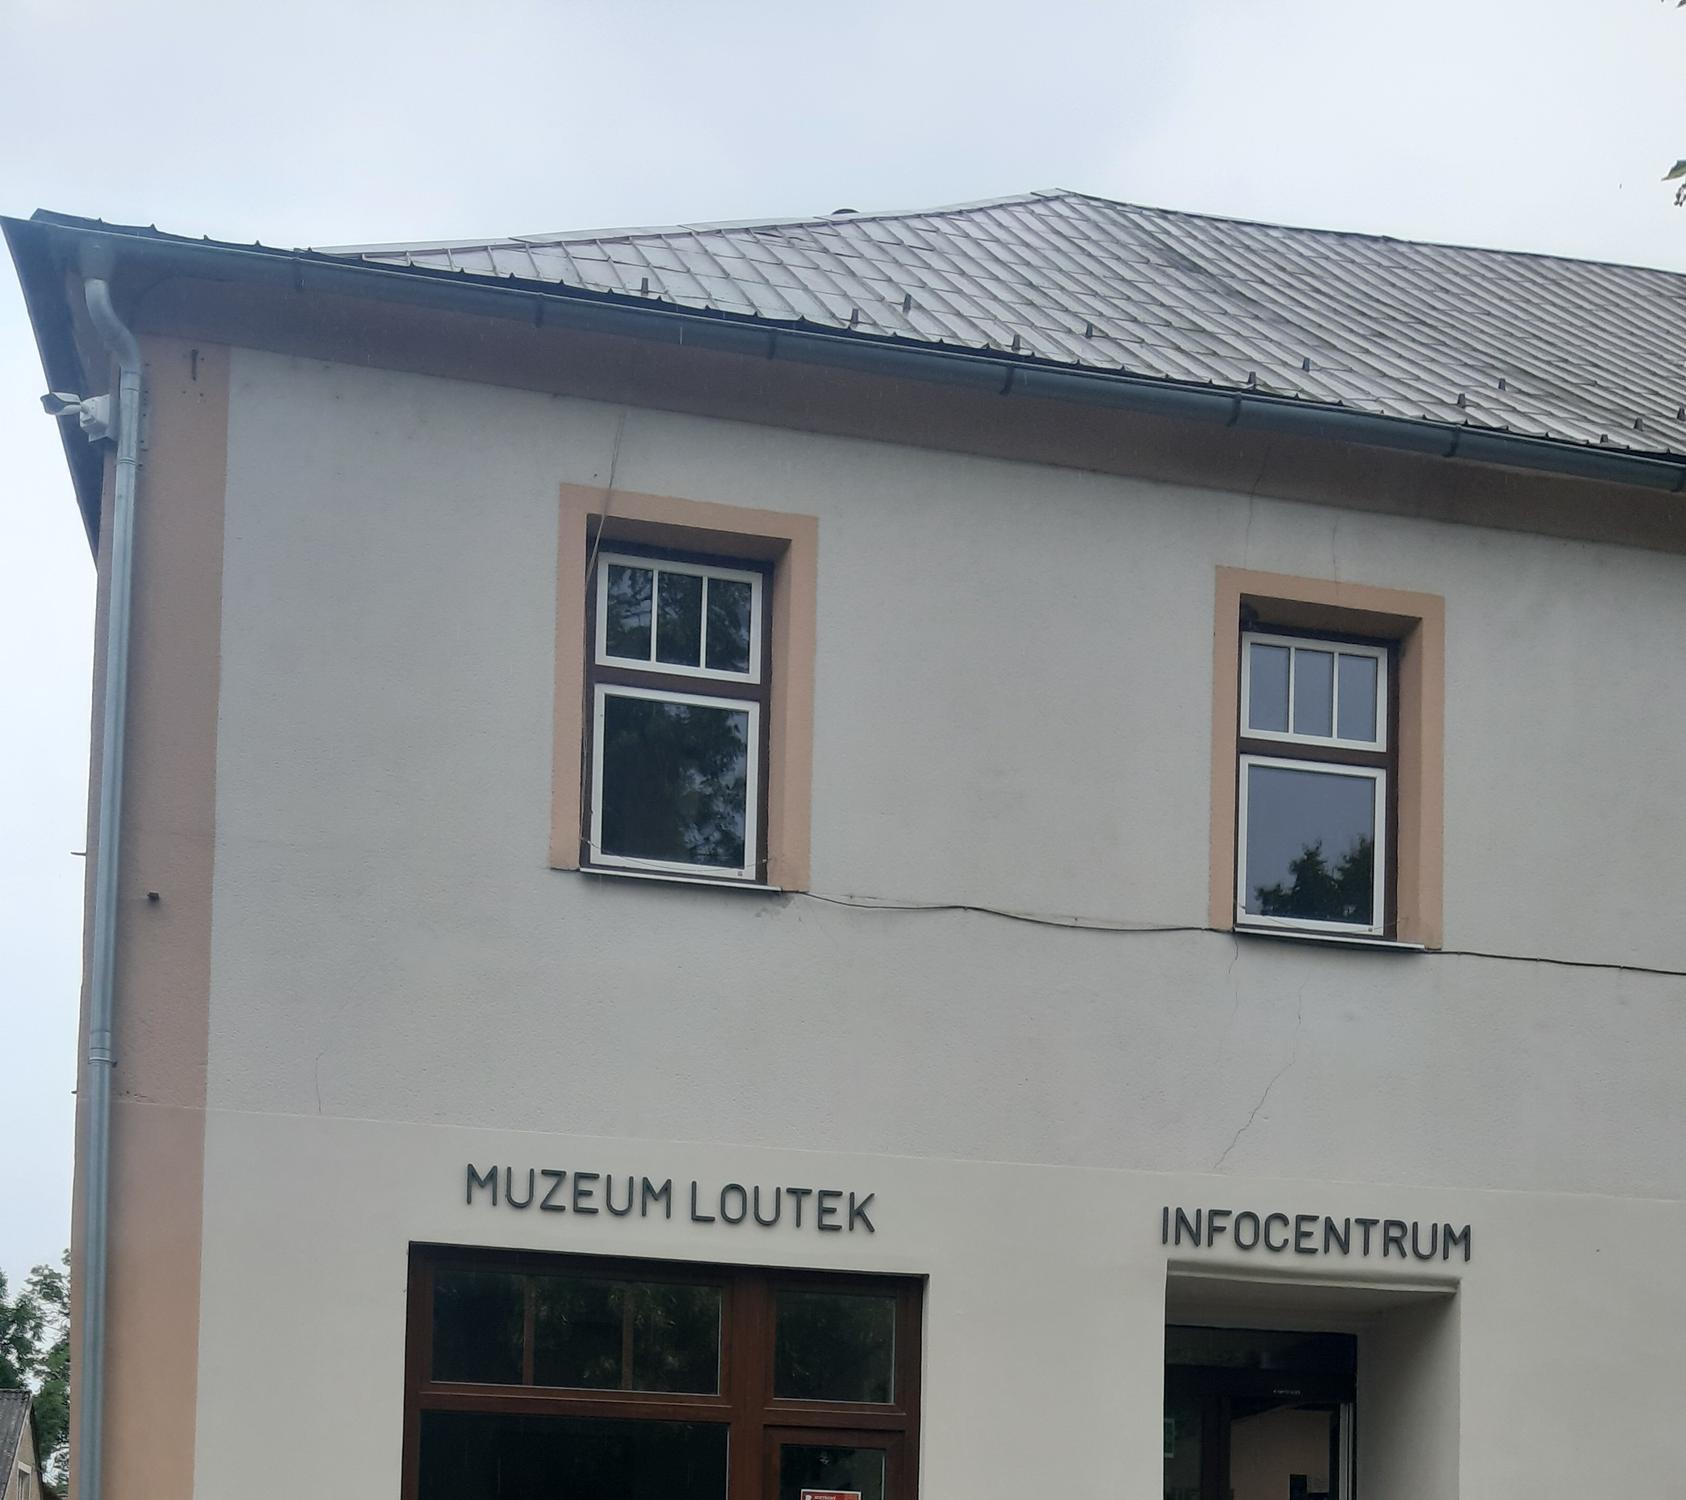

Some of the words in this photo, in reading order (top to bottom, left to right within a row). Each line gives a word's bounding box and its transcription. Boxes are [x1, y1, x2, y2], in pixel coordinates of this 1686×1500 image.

[465, 1163, 673, 1219] MUZEUM
[690, 1180, 876, 1233] LOUTEK
[1162, 1206, 1471, 1262] INFOCENTRUM
